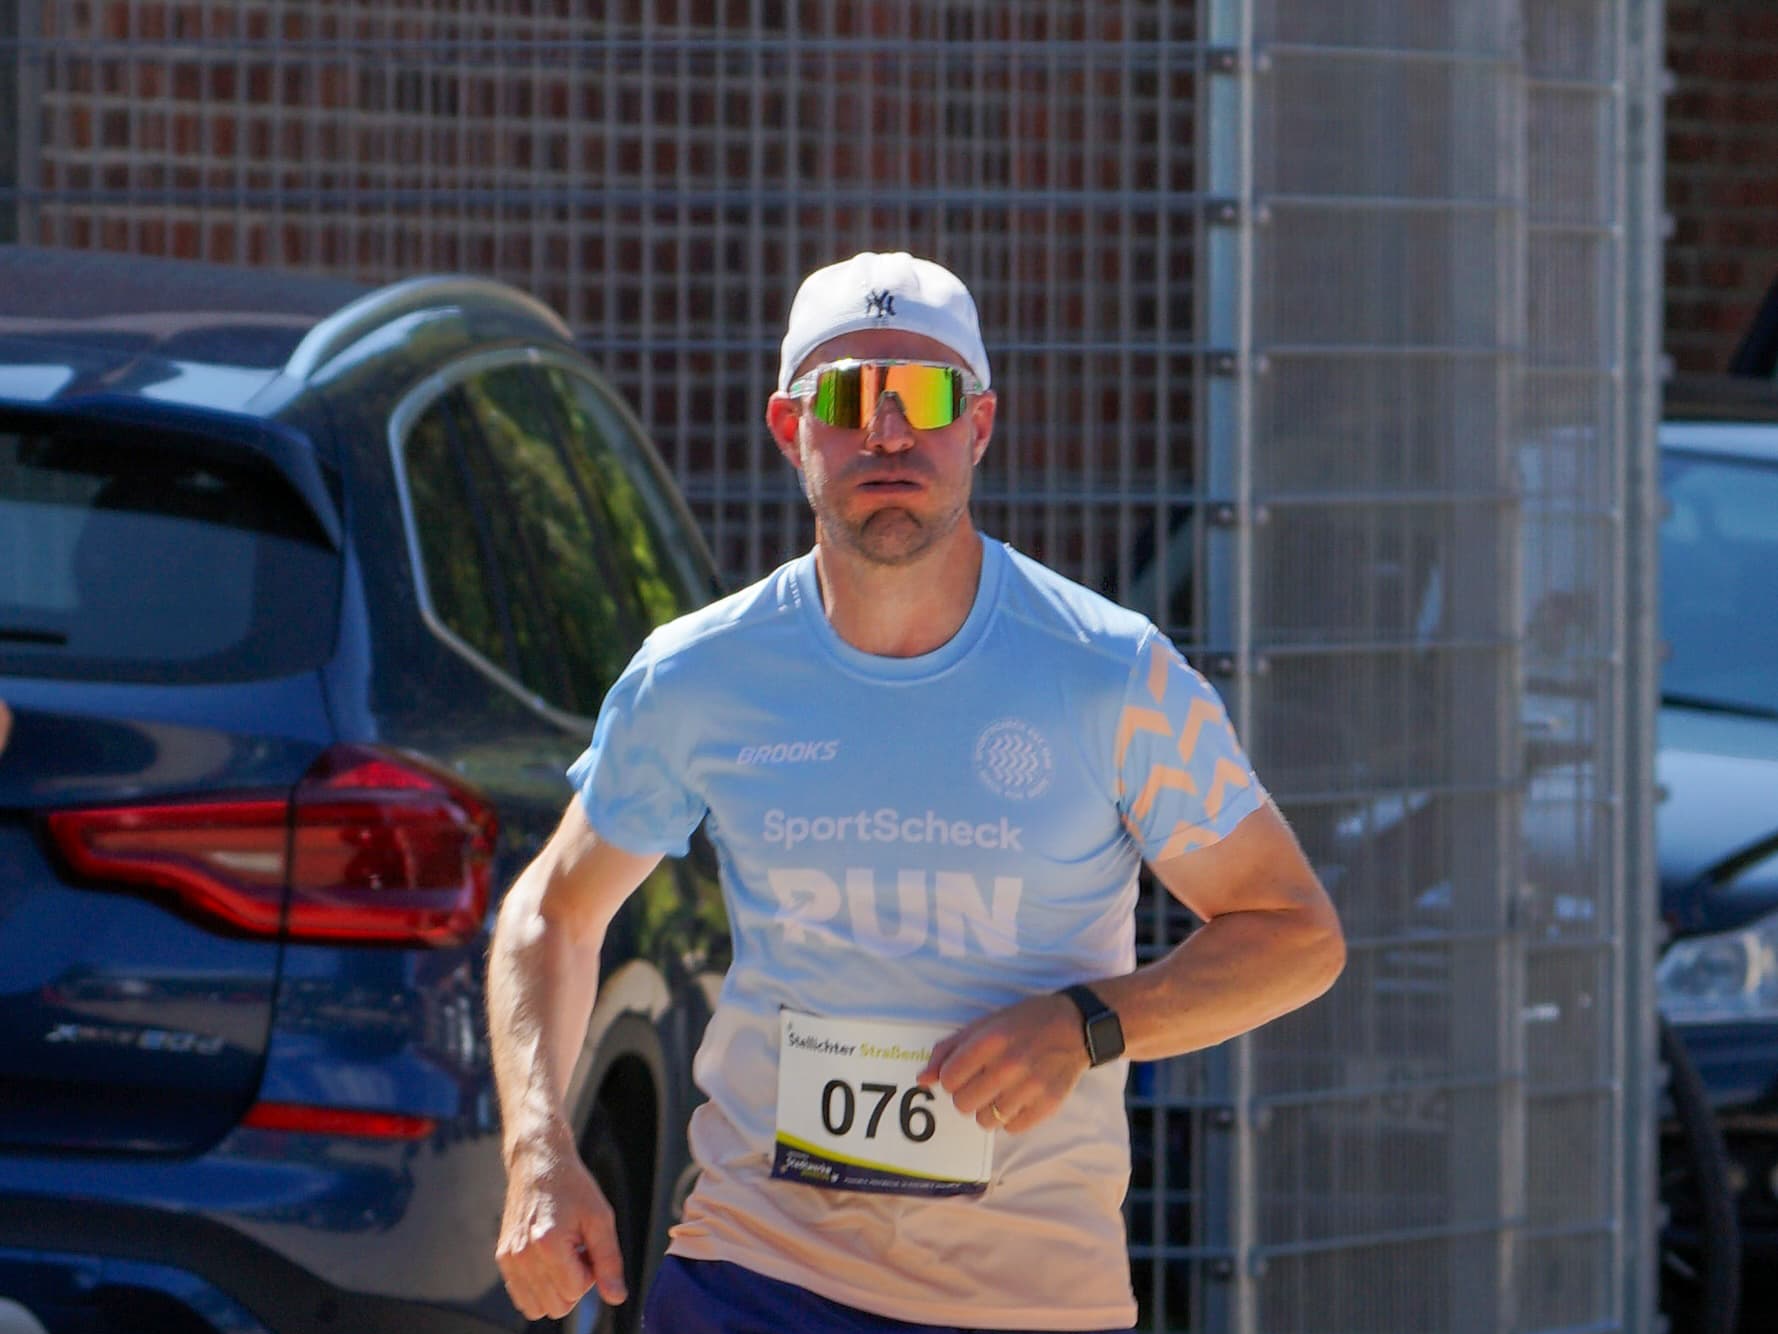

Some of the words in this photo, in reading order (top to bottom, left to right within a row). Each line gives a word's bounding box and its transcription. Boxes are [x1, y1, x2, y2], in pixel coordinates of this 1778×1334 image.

[736, 739, 840, 766] BROOKS
[762, 808, 1023, 851] SportScheck
[767, 867, 1023, 958] RUN
[821, 1079, 937, 1143] 076
